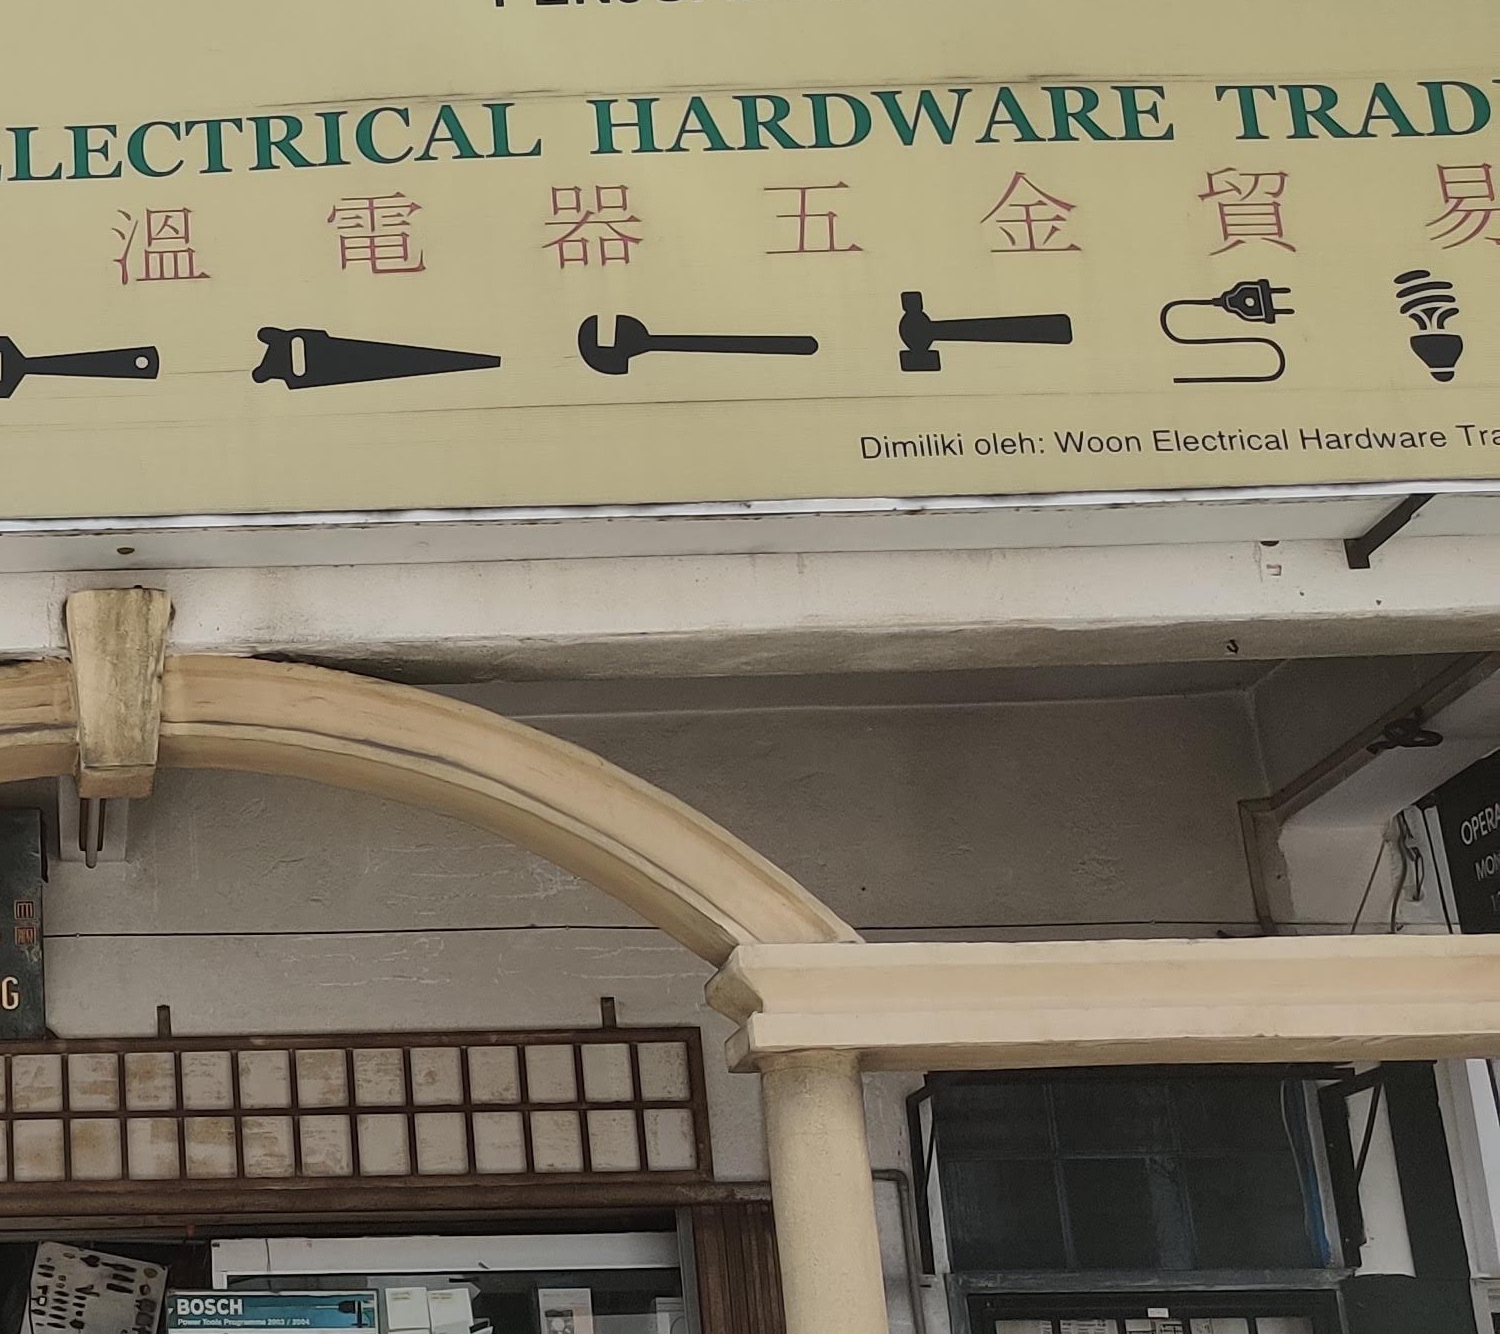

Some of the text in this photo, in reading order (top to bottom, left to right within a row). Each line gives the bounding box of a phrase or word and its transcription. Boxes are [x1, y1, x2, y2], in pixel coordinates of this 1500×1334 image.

[588, 85, 1176, 156] HARDWARE
[1215, 80, 1500, 140] TRAD
[860, 432, 964, 460] Dimiliki
[974, 431, 1045, 456] oleh:
[1054, 430, 1142, 454] Woon
[1152, 428, 1289, 452] Electrical
[1299, 426, 1447, 451] Hardware
[177, 1299, 243, 1315] BOSCH
[224, 1319, 266, 1328] Programme
